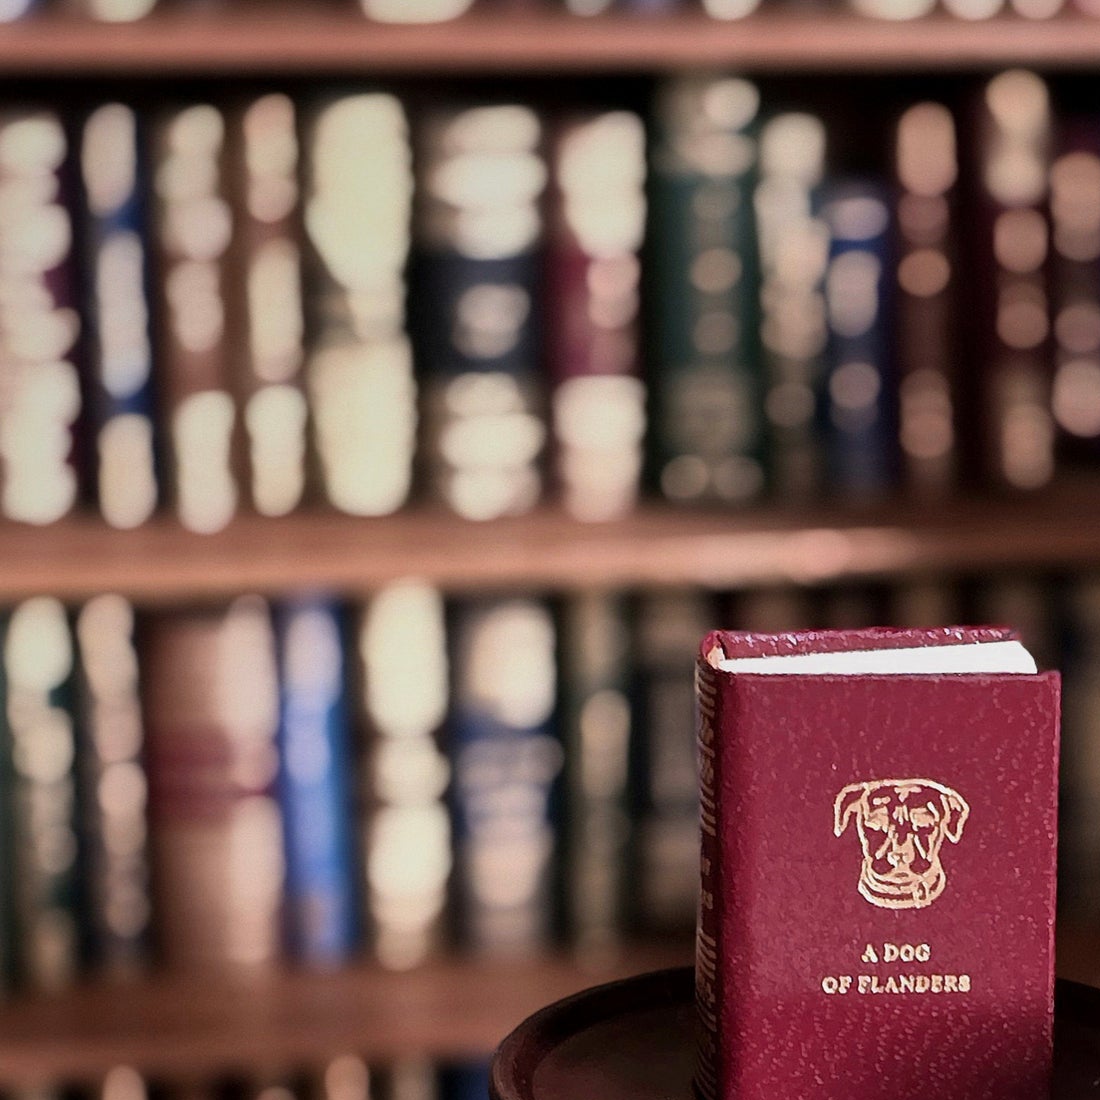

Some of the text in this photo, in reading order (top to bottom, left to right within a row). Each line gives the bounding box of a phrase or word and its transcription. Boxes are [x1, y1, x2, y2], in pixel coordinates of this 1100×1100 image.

[861, 943, 931, 963] A DOG
[822, 974, 970, 994] OF FLANDERS
